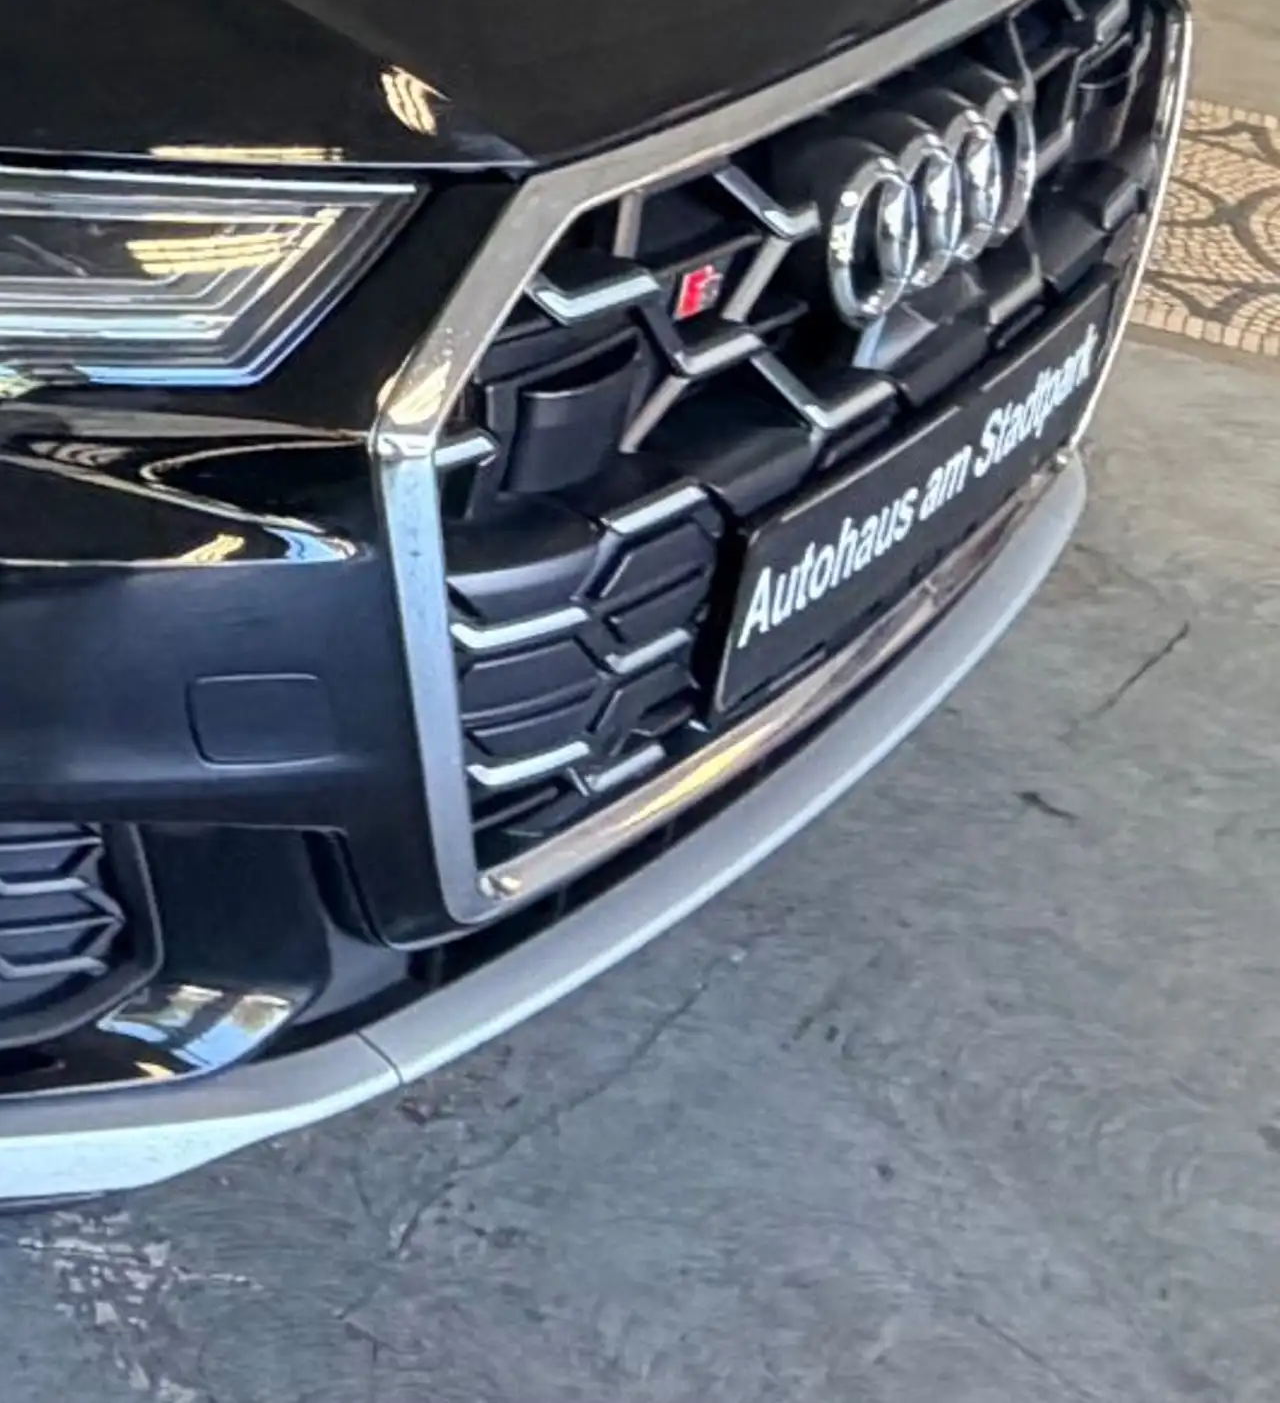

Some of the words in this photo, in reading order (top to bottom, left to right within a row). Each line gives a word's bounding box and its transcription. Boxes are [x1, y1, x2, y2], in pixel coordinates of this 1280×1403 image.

[737, 486, 919, 649] Autohaus
[919, 444, 973, 522] am
[973, 322, 1099, 479] Stadtpark
